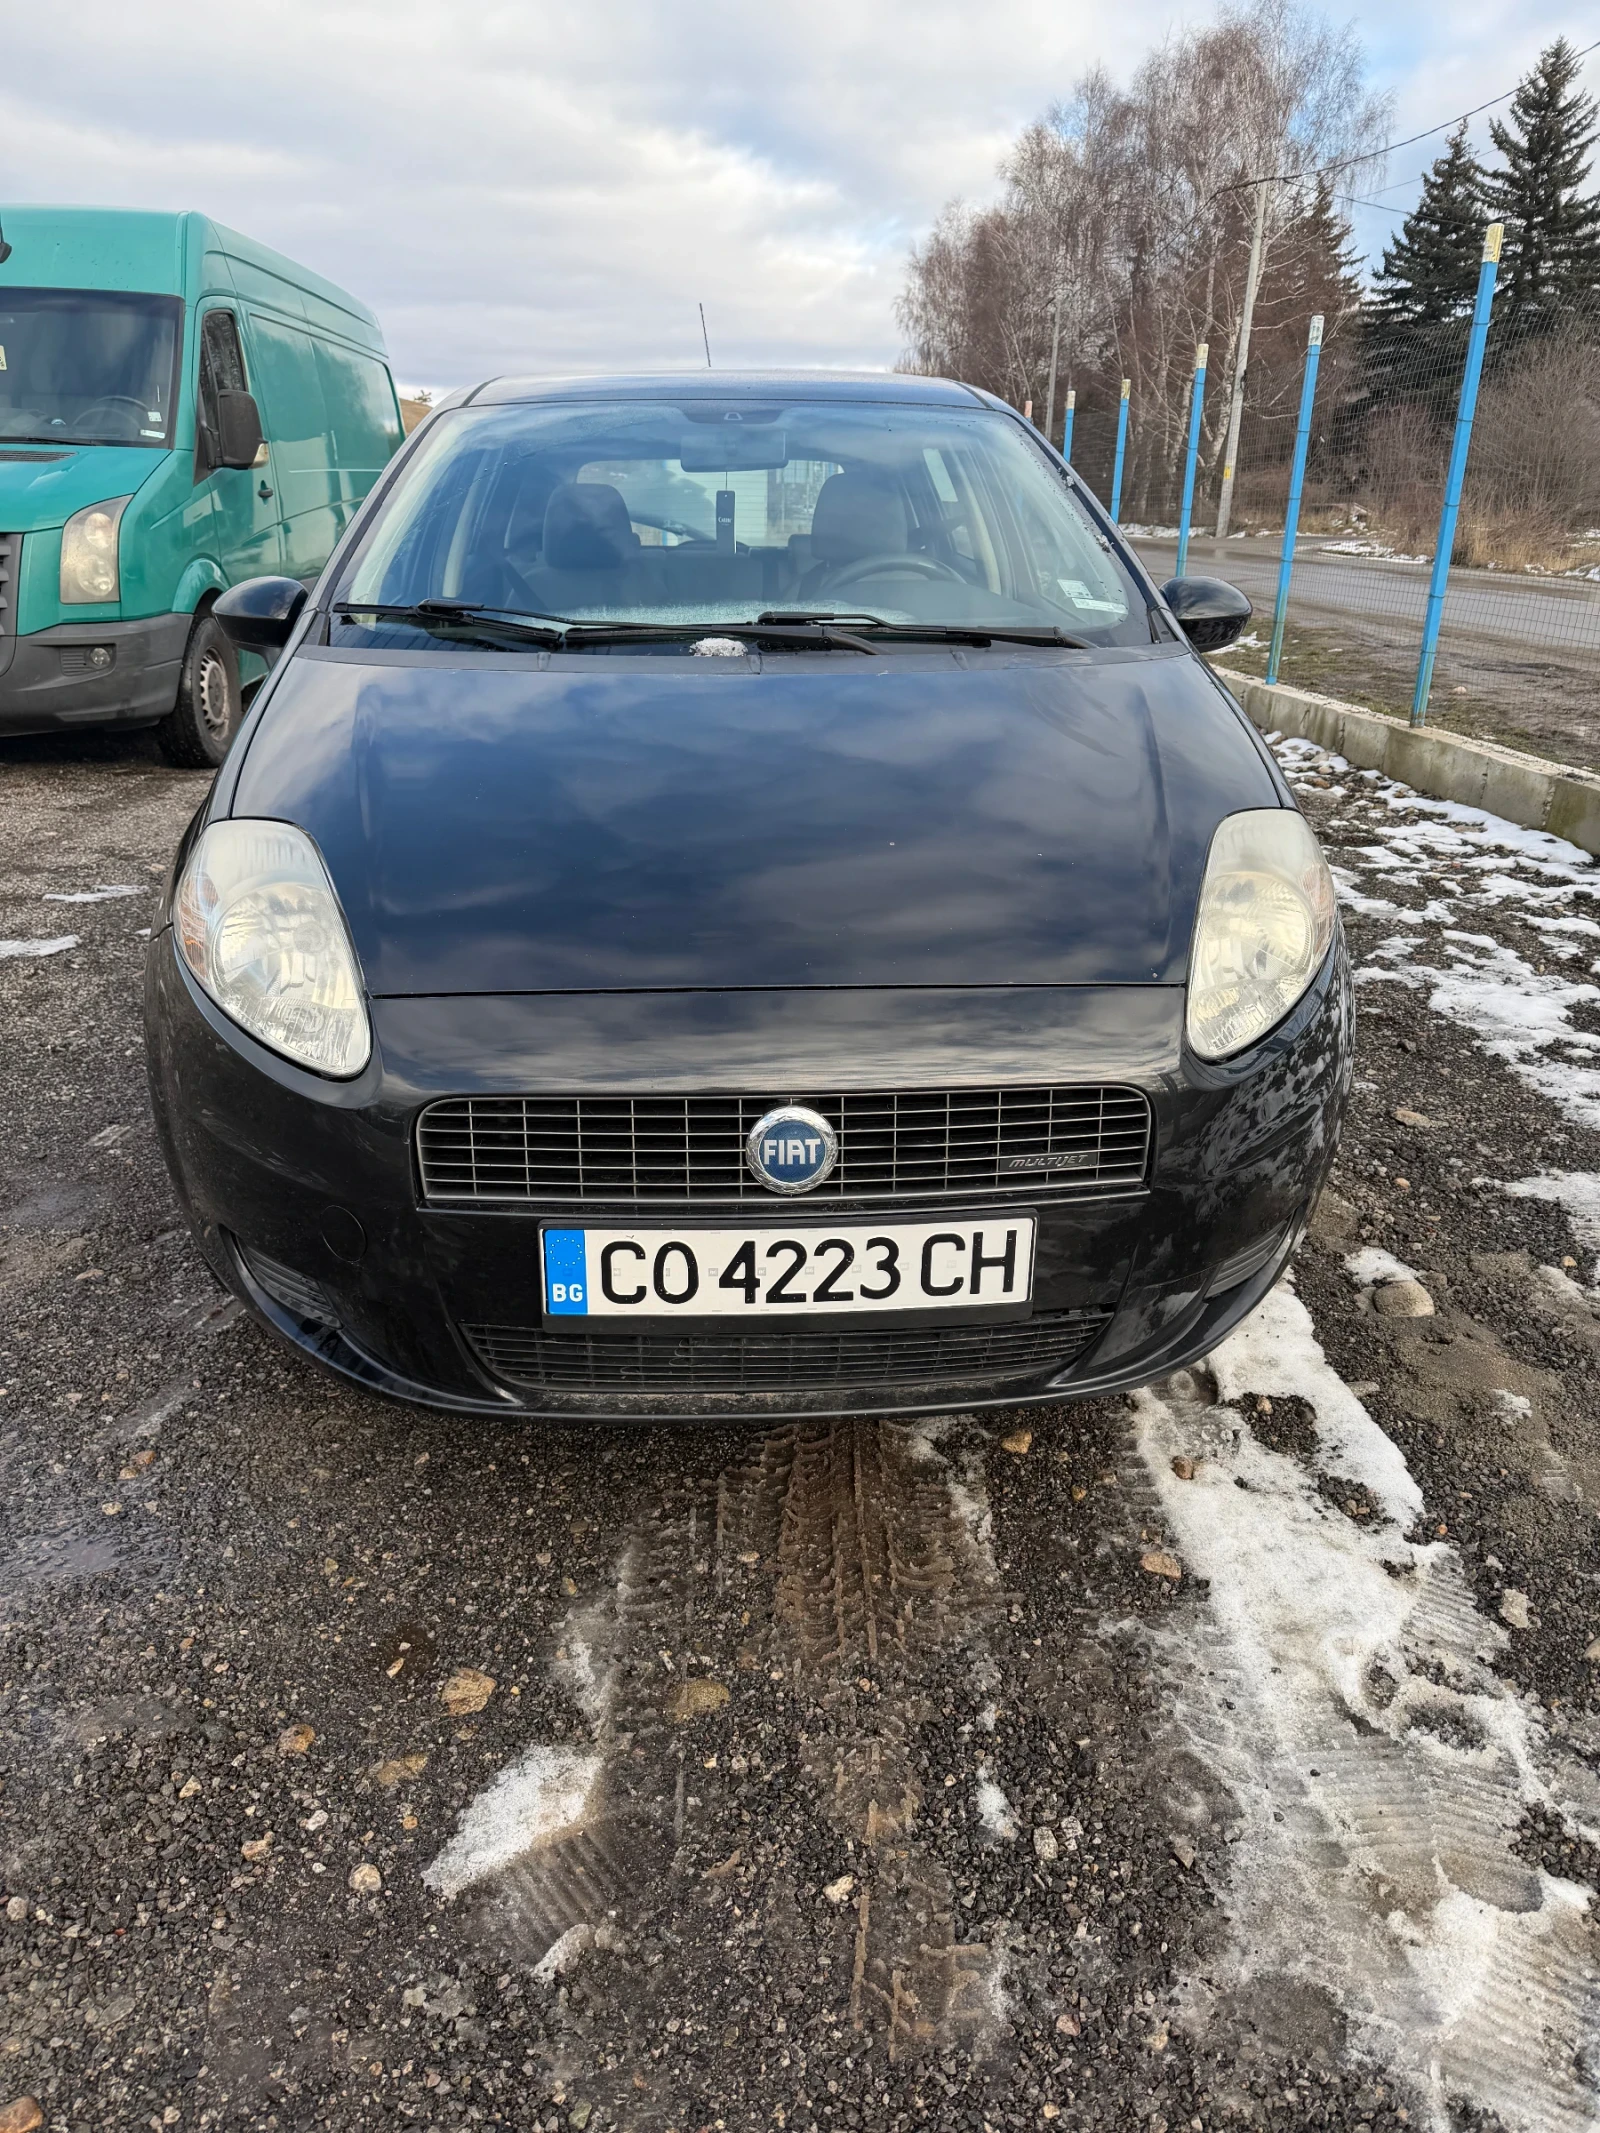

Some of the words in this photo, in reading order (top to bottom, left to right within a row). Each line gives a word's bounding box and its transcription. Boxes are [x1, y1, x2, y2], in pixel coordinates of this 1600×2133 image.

[763, 1138, 821, 1165] FIAT
[1008, 1154, 1089, 1168] MULTIJET
[600, 1240, 700, 1305] CO
[718, 1236, 902, 1304] 4223
[920, 1229, 1018, 1297] CH
[552, 1283, 583, 1302] BG
